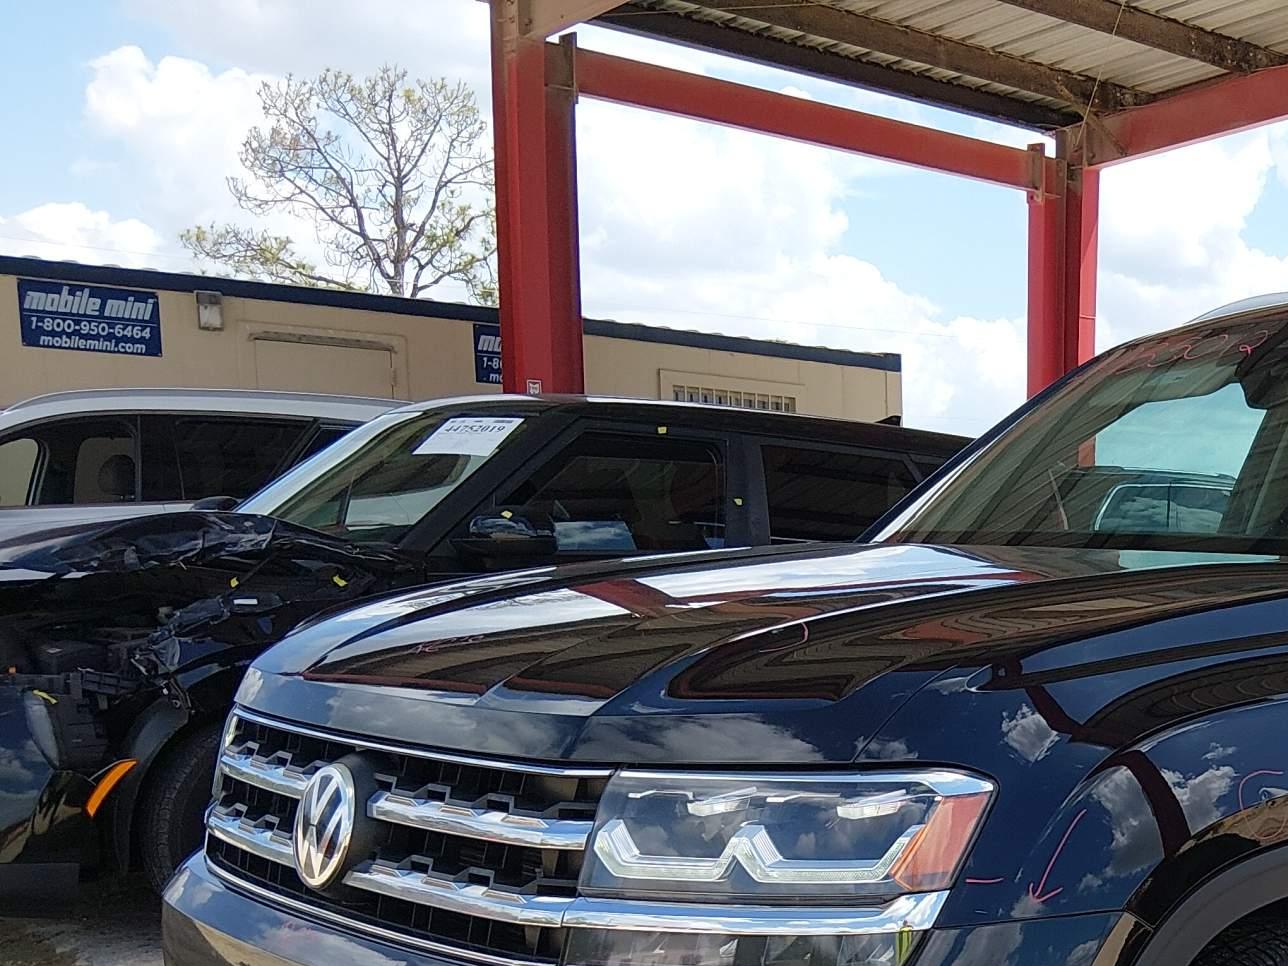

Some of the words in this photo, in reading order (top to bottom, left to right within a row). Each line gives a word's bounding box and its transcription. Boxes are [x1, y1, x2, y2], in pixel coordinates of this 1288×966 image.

[23, 285, 102, 316] mobile
[103, 295, 157, 321] mini
[30, 316, 152, 340] 1-800-950-6464
[39, 334, 147, 354] mobilemini.com
